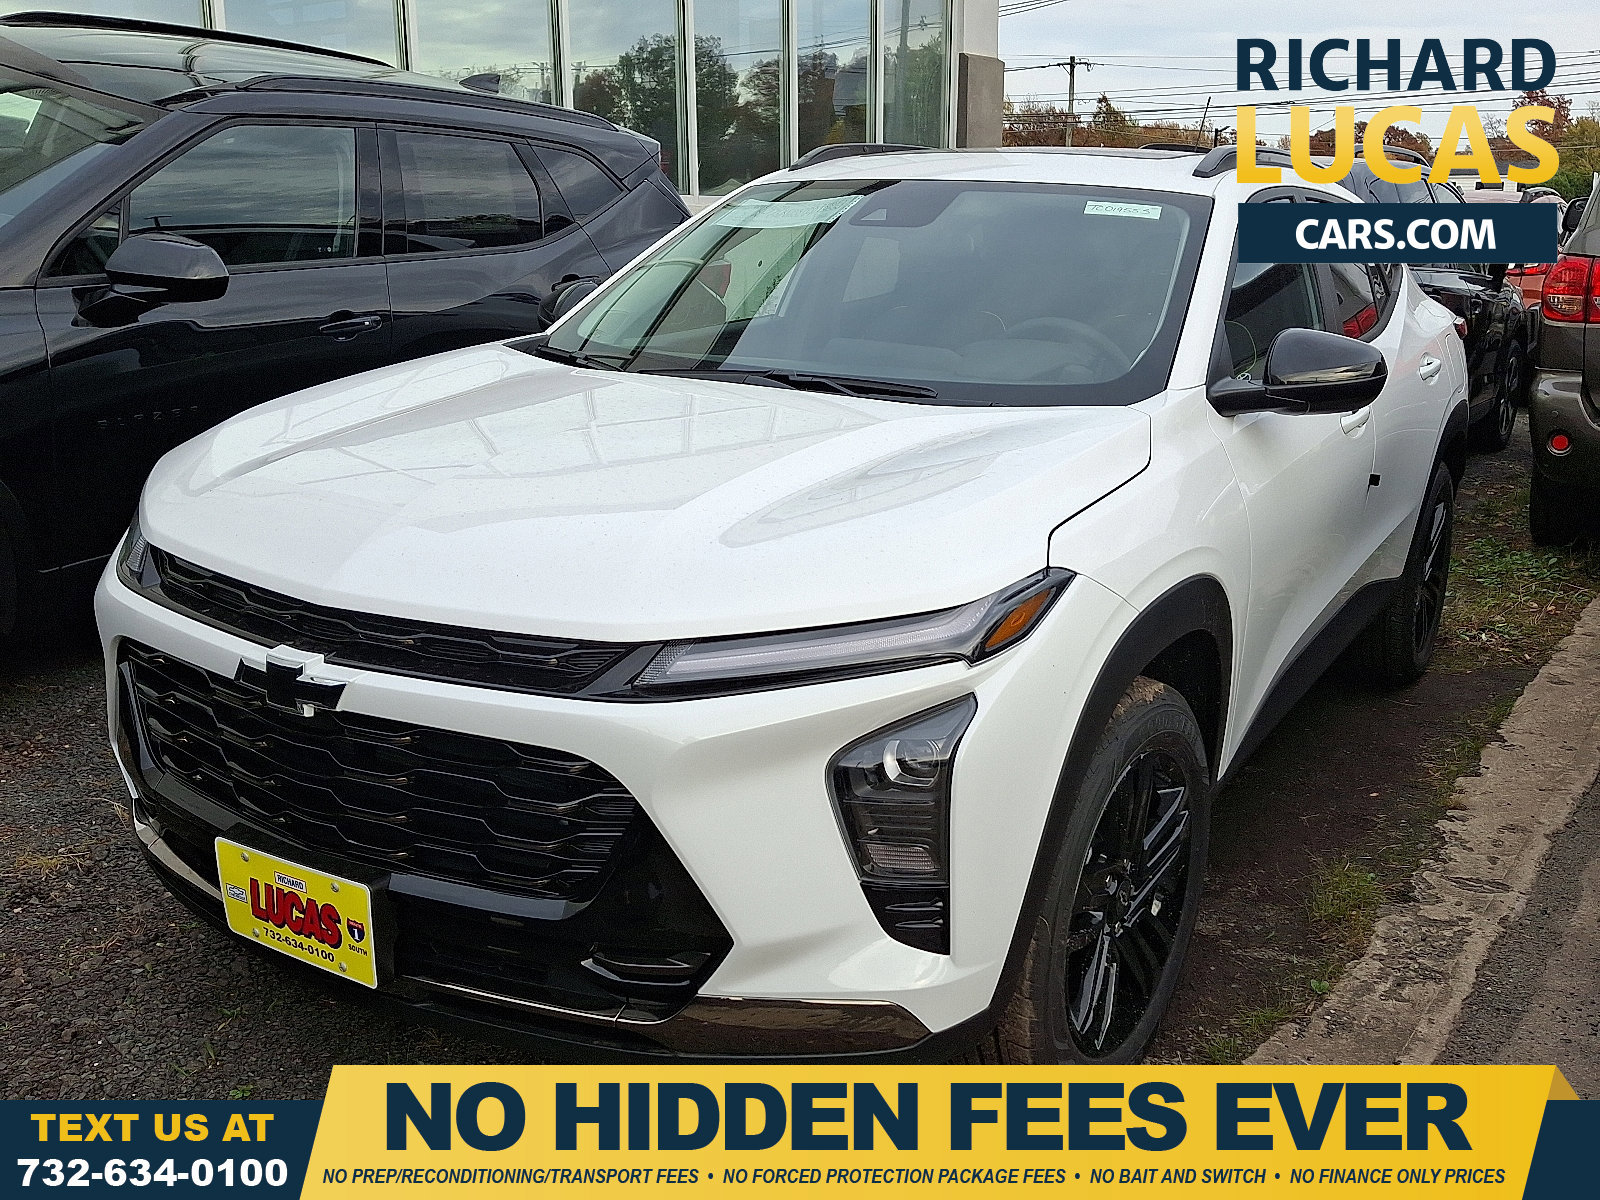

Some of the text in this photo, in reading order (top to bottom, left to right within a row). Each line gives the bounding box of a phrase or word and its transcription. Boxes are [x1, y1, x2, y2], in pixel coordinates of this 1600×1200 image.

[276, 873, 305, 891] RICHARD
[250, 877, 343, 949] LUCAS
[352, 928, 361, 942] 1
[262, 926, 335, 963] 732-634-0100
[348, 943, 368, 957] SOUTH
